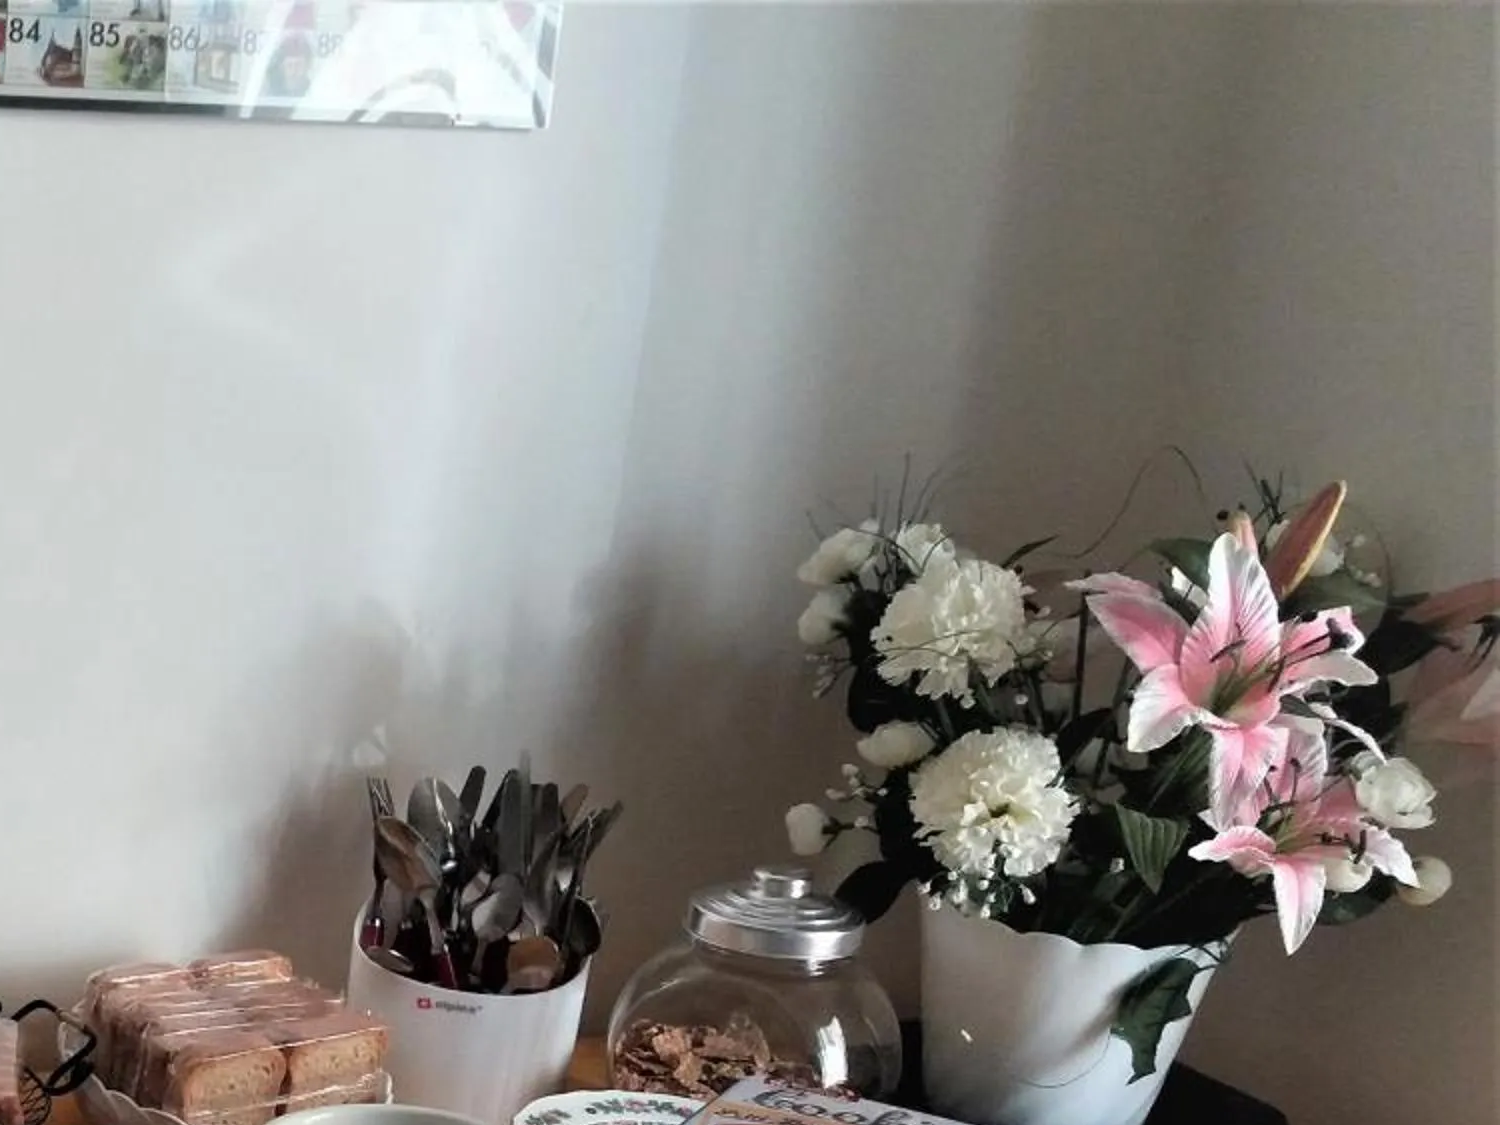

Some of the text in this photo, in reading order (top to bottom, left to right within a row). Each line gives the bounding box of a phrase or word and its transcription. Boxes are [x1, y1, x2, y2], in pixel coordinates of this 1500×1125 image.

[9, 18, 41, 43] 84
[89, 22, 120, 48] 85
[169, 26, 200, 52] 86
